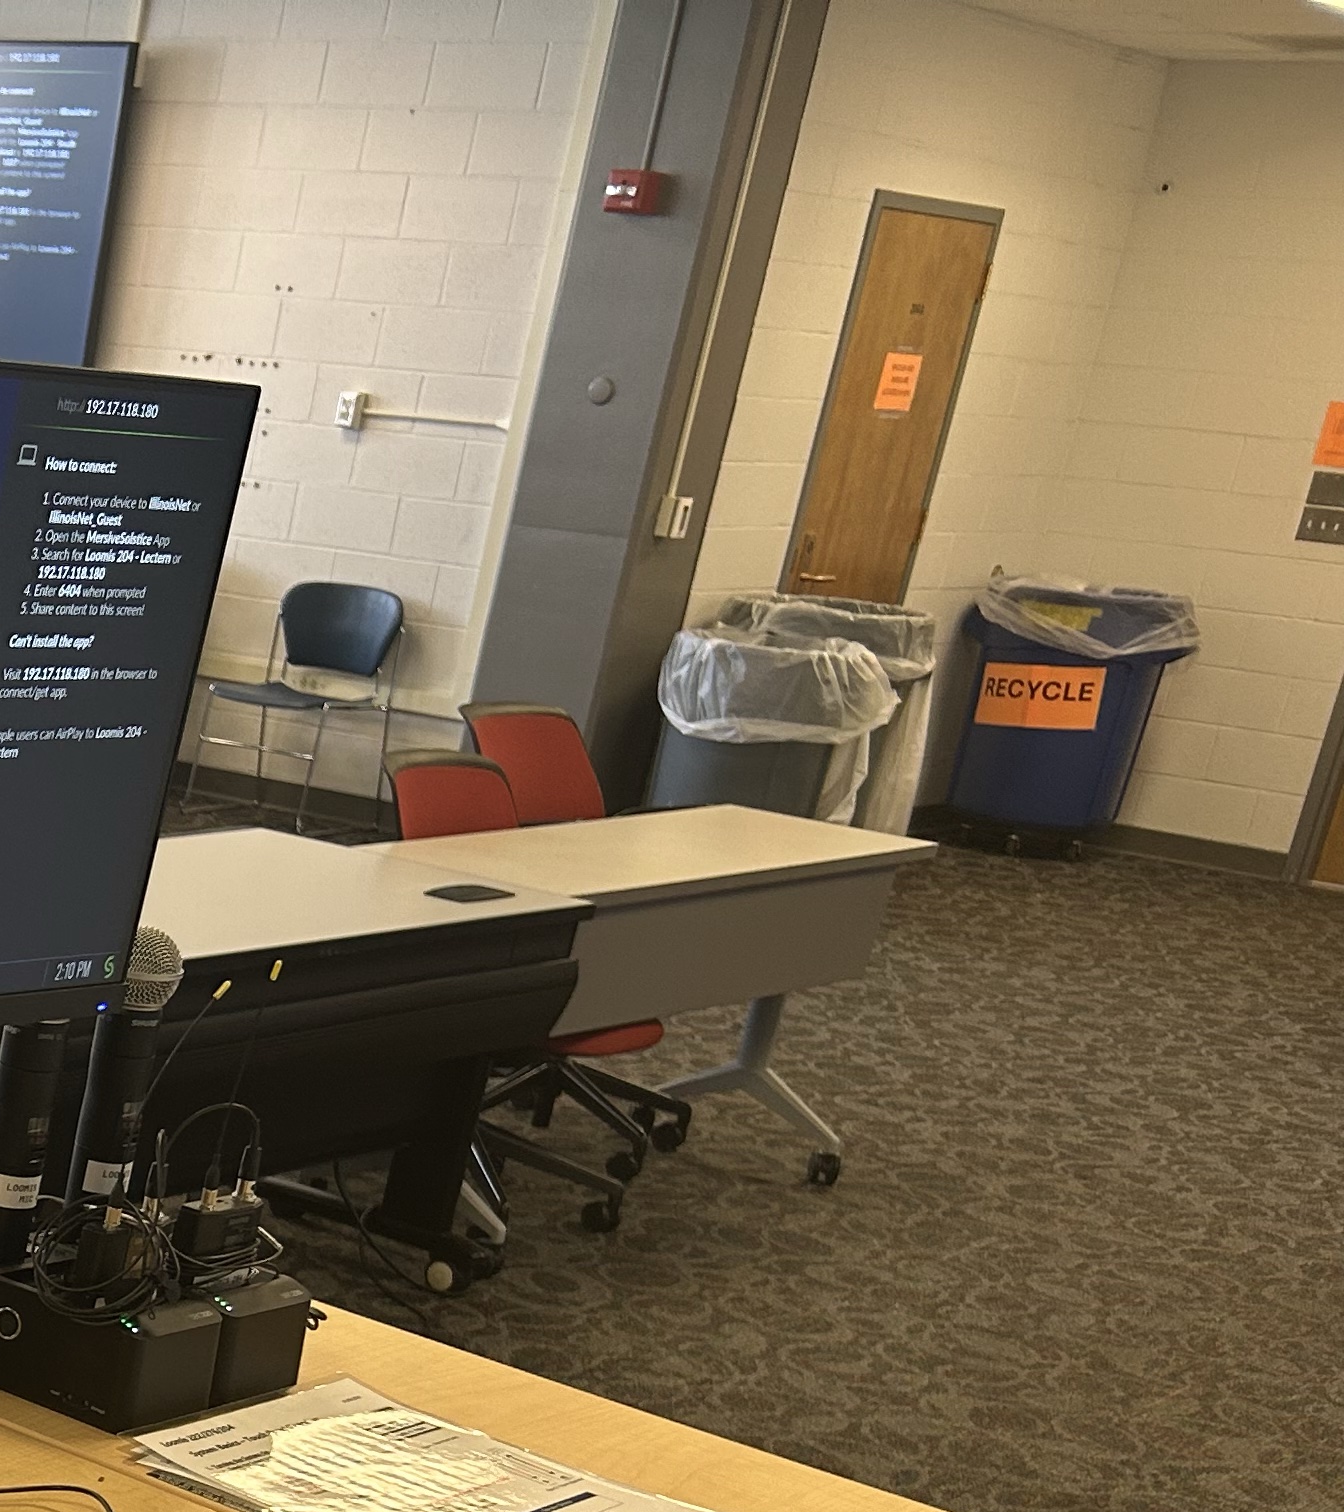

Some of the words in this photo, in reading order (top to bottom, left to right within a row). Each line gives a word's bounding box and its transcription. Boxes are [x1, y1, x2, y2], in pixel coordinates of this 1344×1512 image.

[45, 456, 67, 471] How
[68, 458, 78, 471] to
[53, 492, 89, 506] Connect
[90, 497, 109, 510] your
[110, 496, 136, 509] device
[138, 498, 147, 509] to
[45, 530, 69, 544] Open
[71, 532, 85, 543] the
[153, 534, 171, 548] App
[41, 548, 69, 561] Search
[71, 549, 84, 561] for
[85, 549, 115, 563] Loomis
[117, 550, 134, 563] 204
[140, 551, 172, 564] Lectern
[34, 583, 57, 597] Enter
[58, 584, 82, 598] 6404
[82, 586, 105, 598] when
[106, 586, 147, 601] prompted
[30, 602, 54, 615] Share
[55, 603, 88, 616] content
[88, 604, 97, 616] to
[99, 603, 115, 616] this
[59, 635, 73, 648] the
[73, 635, 95, 651] app?
[3, 667, 21, 681] Visit
[91, 668, 99, 680] in
[100, 667, 114, 680] the
[115, 667, 147, 680] browser
[148, 668, 158, 680] to
[985, 677, 1095, 702] RECYCLE
[16, 729, 38, 741] users
[39, 730, 54, 741] can
[55, 726, 83, 742] AirPlay
[84, 727, 95, 739] to
[95, 725, 124, 739] Loomis
[124, 725, 142, 738] 204
[54, 961, 75, 980] 2:10
[76, 960, 92, 979] PM
